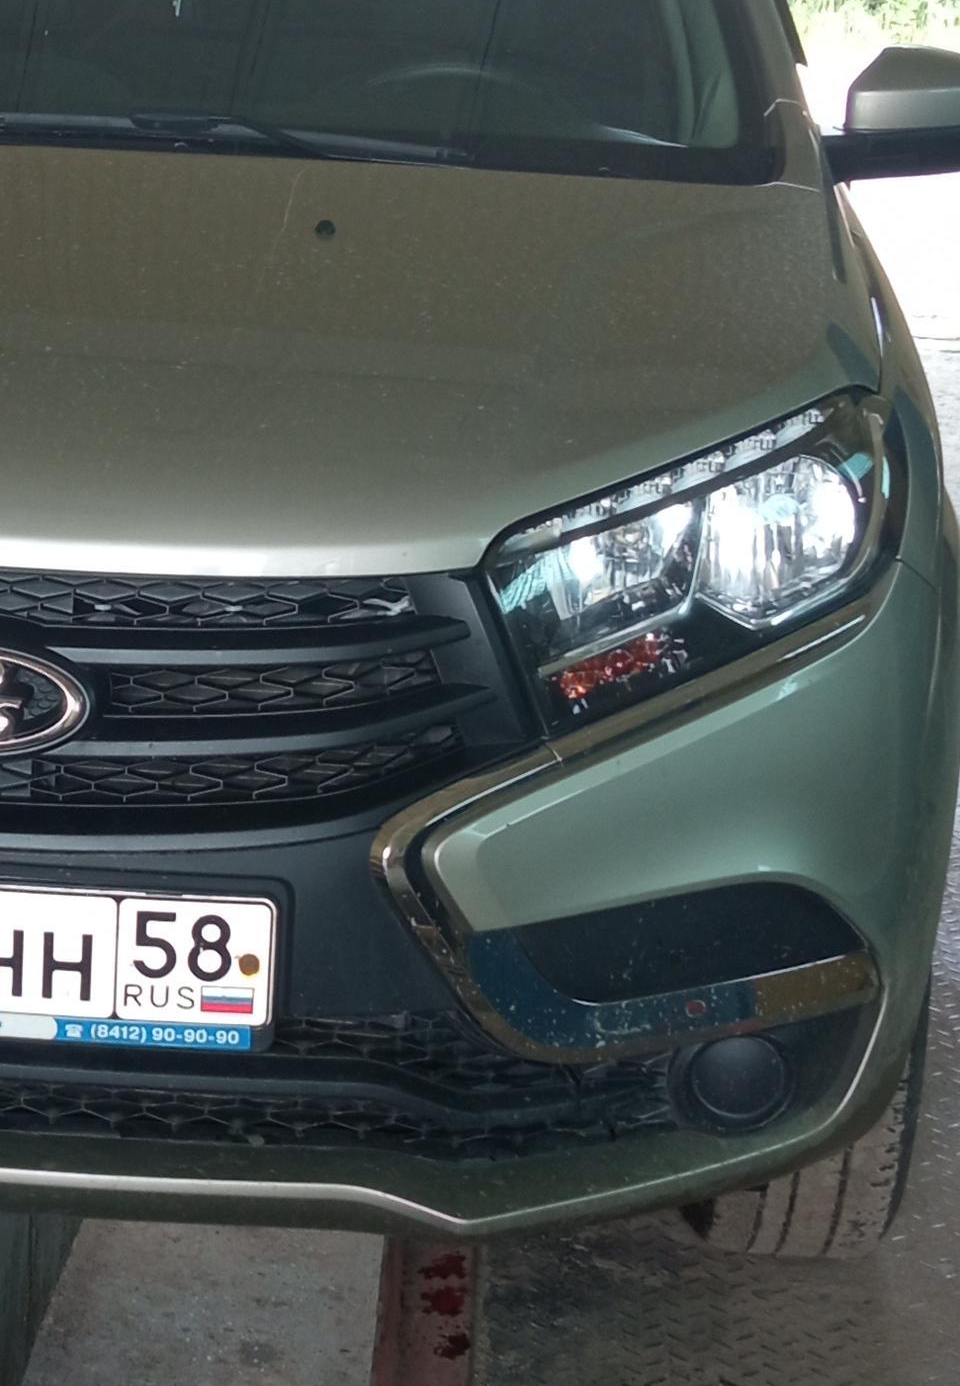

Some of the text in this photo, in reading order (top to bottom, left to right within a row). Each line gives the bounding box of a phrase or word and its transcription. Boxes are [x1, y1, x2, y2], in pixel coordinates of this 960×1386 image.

[132, 910, 232, 983] 58
[123, 983, 195, 1010] RUS
[90, 1023, 240, 1045] (8412) 90-90-90
